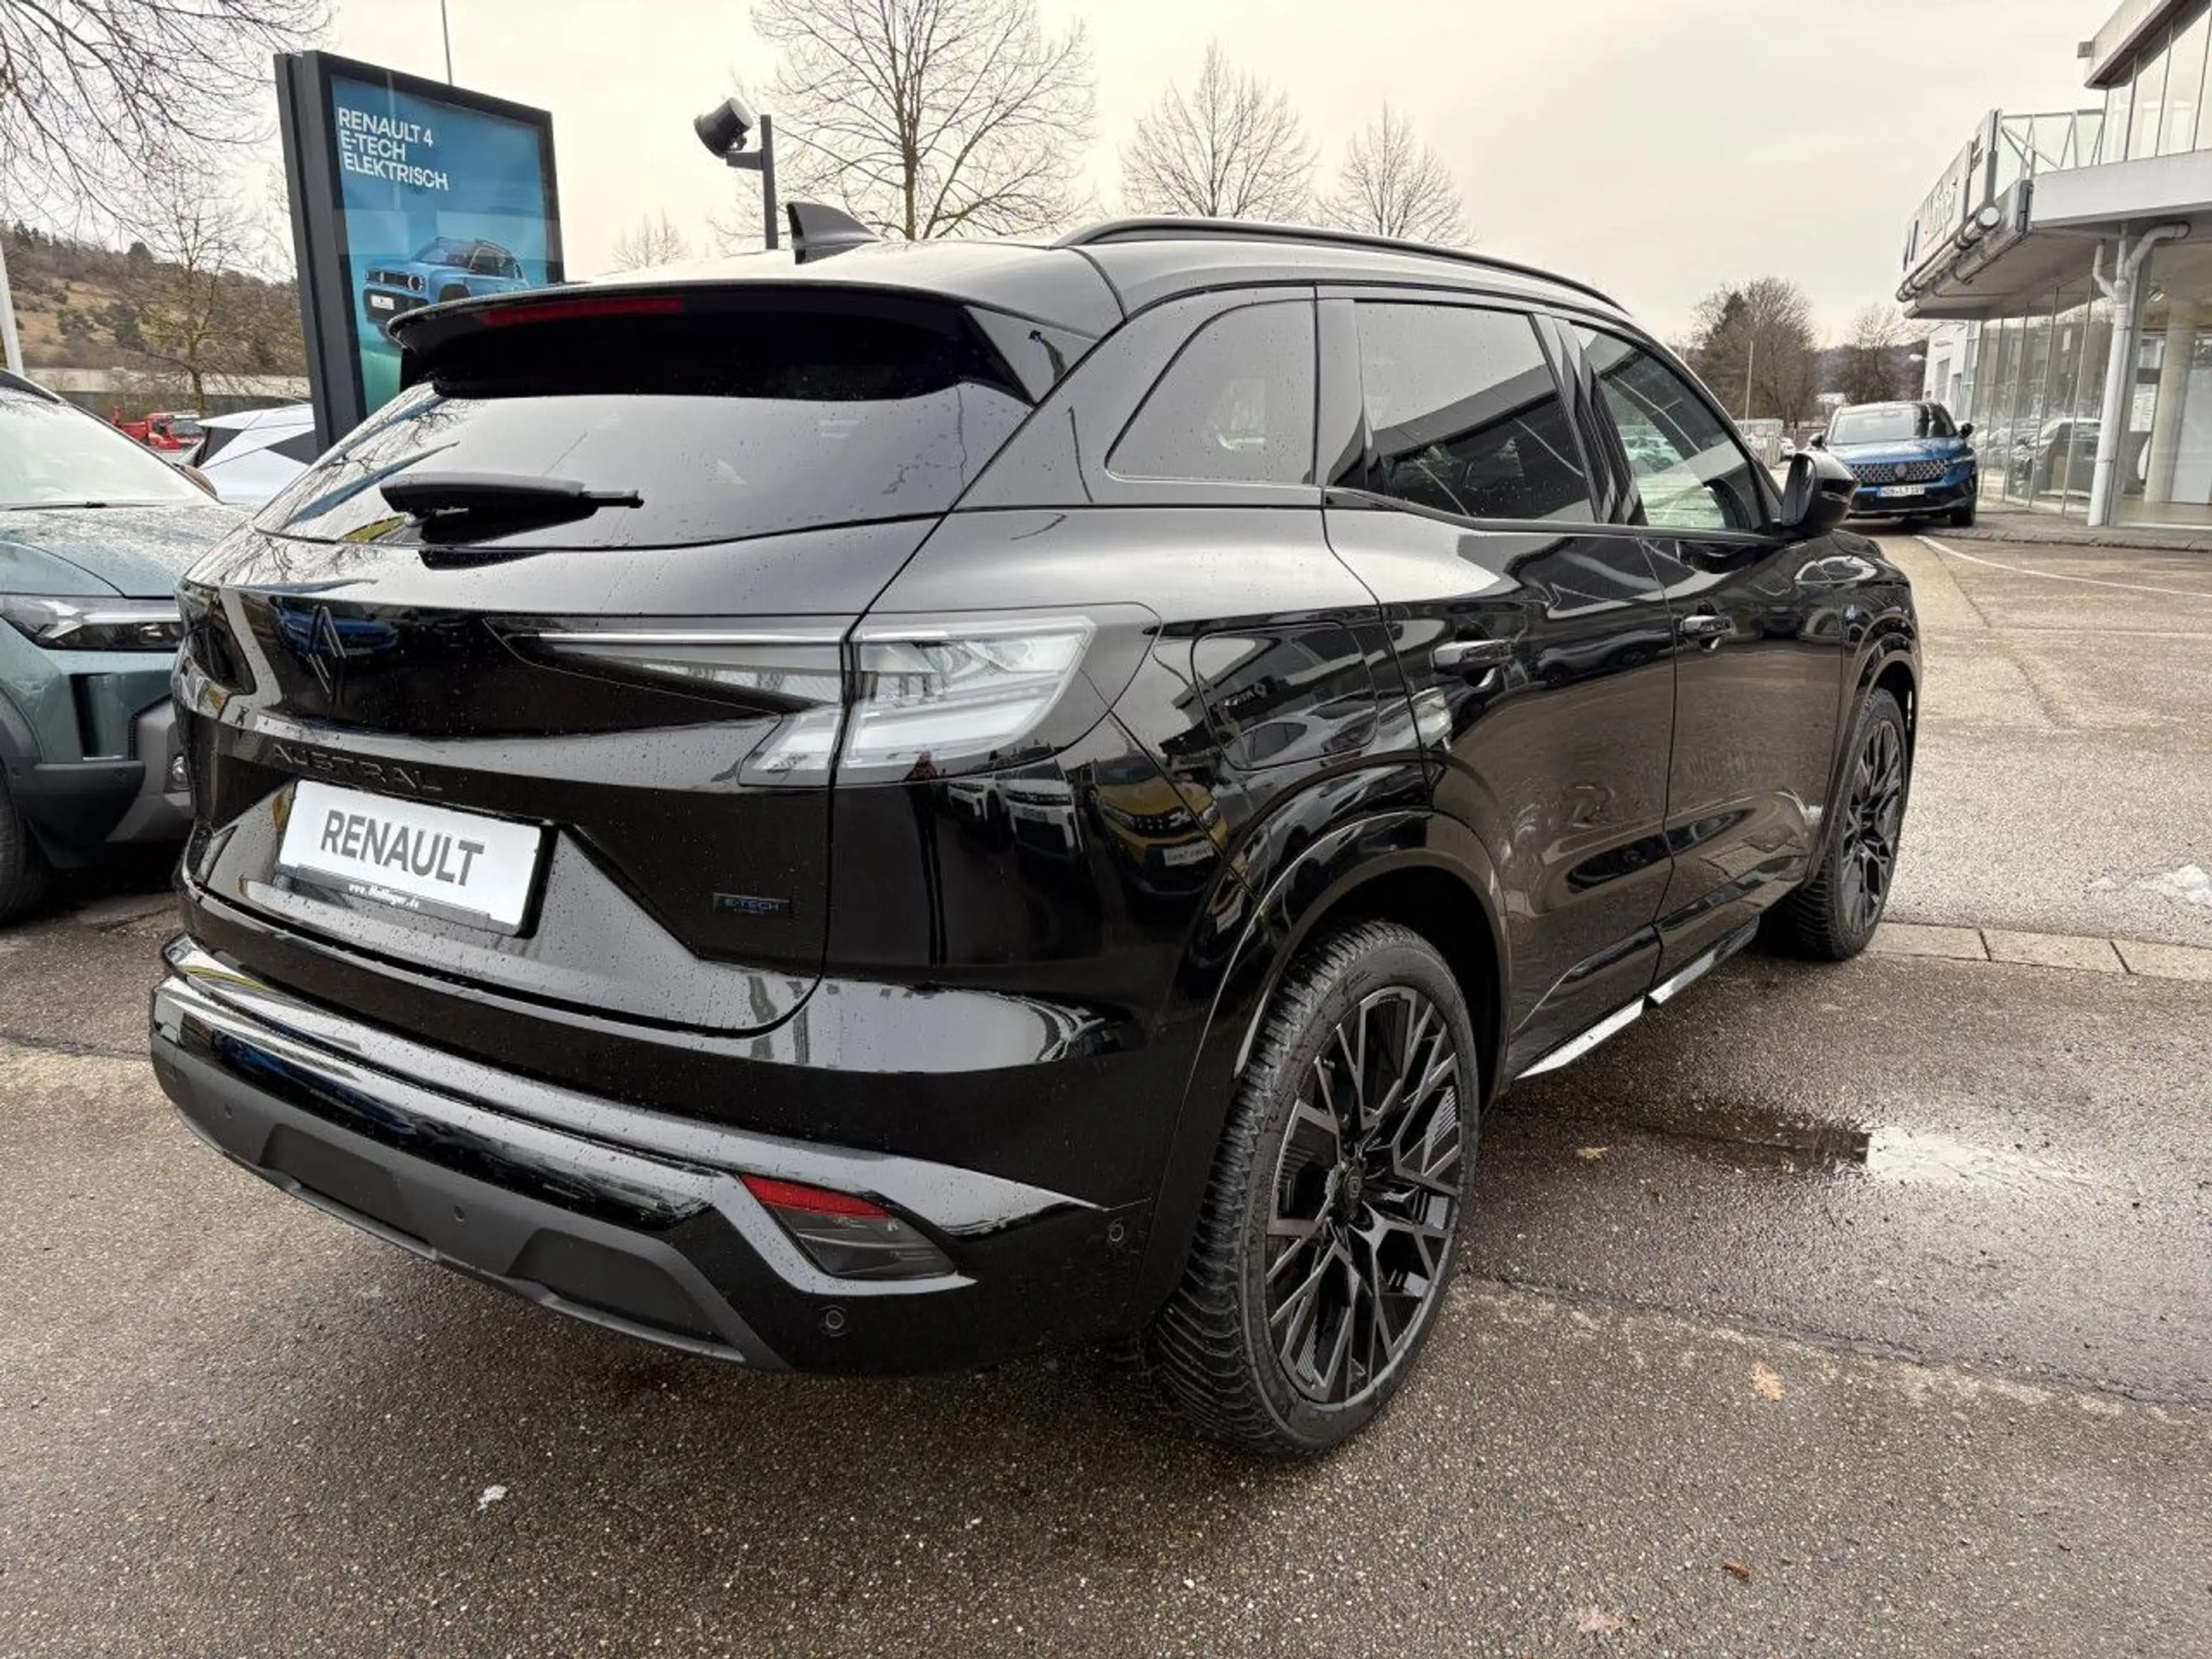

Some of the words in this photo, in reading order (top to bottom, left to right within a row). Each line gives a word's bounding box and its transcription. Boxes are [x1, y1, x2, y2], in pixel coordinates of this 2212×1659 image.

[338, 107, 421, 143] RENAULT
[423, 128, 434, 148] 4
[340, 130, 406, 161] E-TECH
[343, 151, 449, 191] ELEKTRISCH
[273, 743, 444, 793] AUSTRAL
[320, 809, 485, 887] RENAULT
